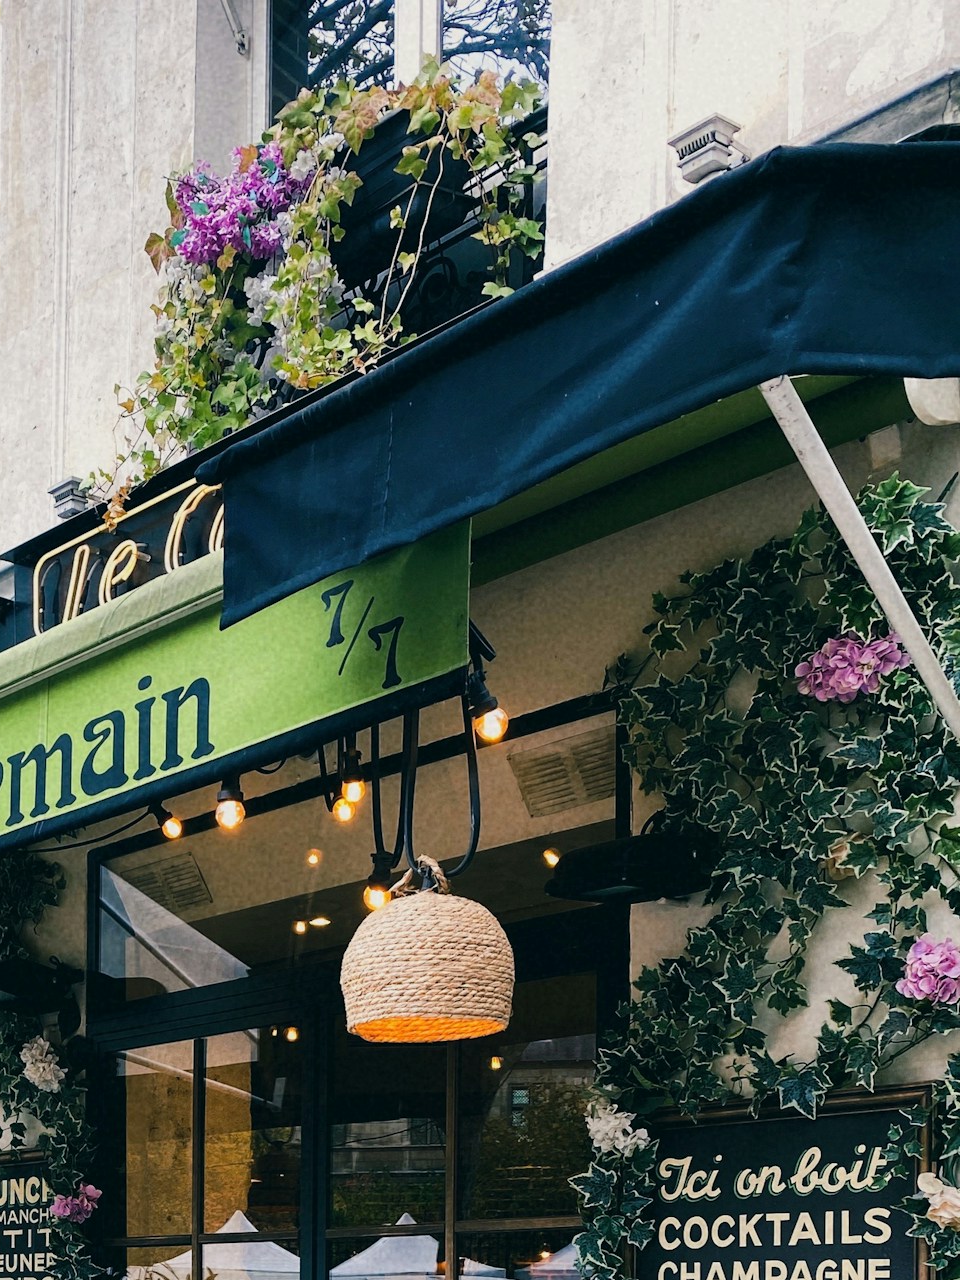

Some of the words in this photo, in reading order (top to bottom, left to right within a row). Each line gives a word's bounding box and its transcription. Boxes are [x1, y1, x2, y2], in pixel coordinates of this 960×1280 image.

[320, 580, 405, 690] 7/7
[734, 1165, 787, 1199] on
[787, 1144, 892, 1196] boit
[657, 1207, 892, 1251] COCKTAILS
